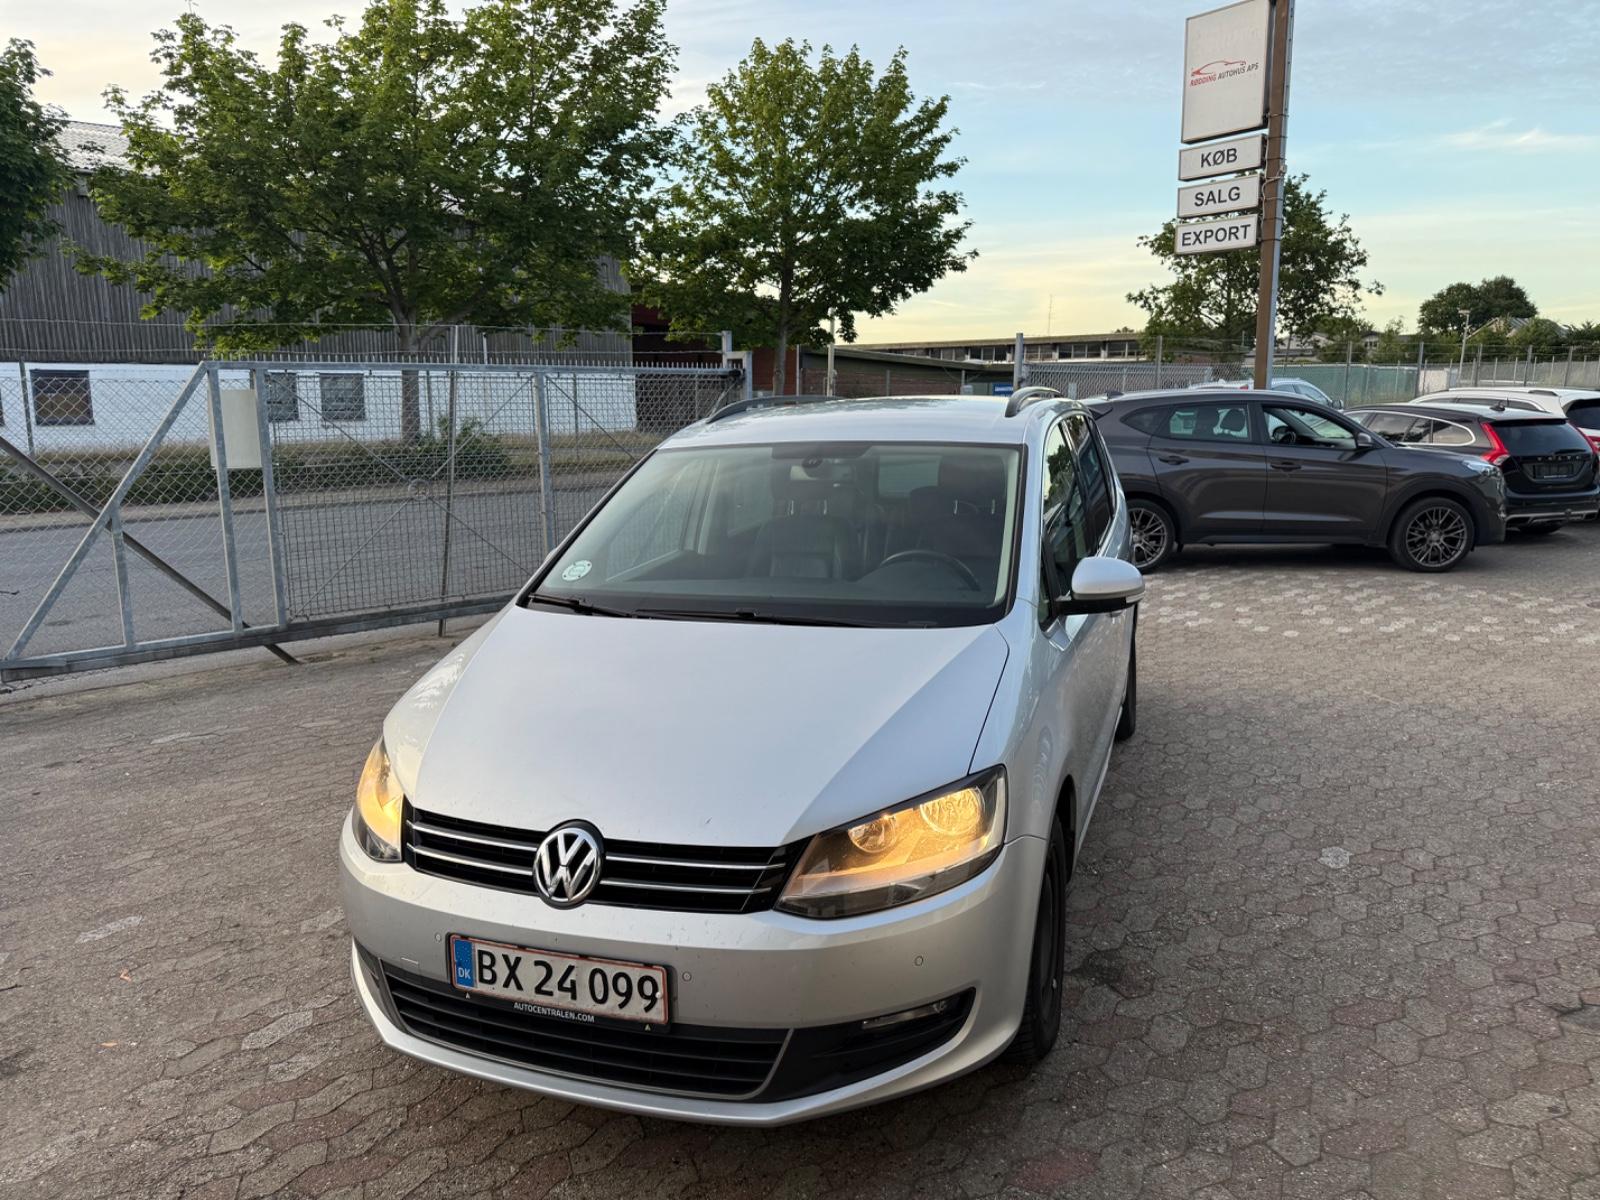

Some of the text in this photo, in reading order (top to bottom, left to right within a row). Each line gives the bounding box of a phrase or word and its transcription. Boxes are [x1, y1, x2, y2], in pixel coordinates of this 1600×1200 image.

[1218, 66, 1245, 80] AUTOHUS
[1246, 62, 1259, 72] APS
[1200, 148, 1238, 168] KØB
[1194, 186, 1241, 207] SALG
[1182, 224, 1251, 247] EXPORT
[458, 967, 471, 980] DK
[477, 949, 660, 1013] BX 24 099
[513, 1002, 595, 1023] AUTOCENTRALEN.COM
